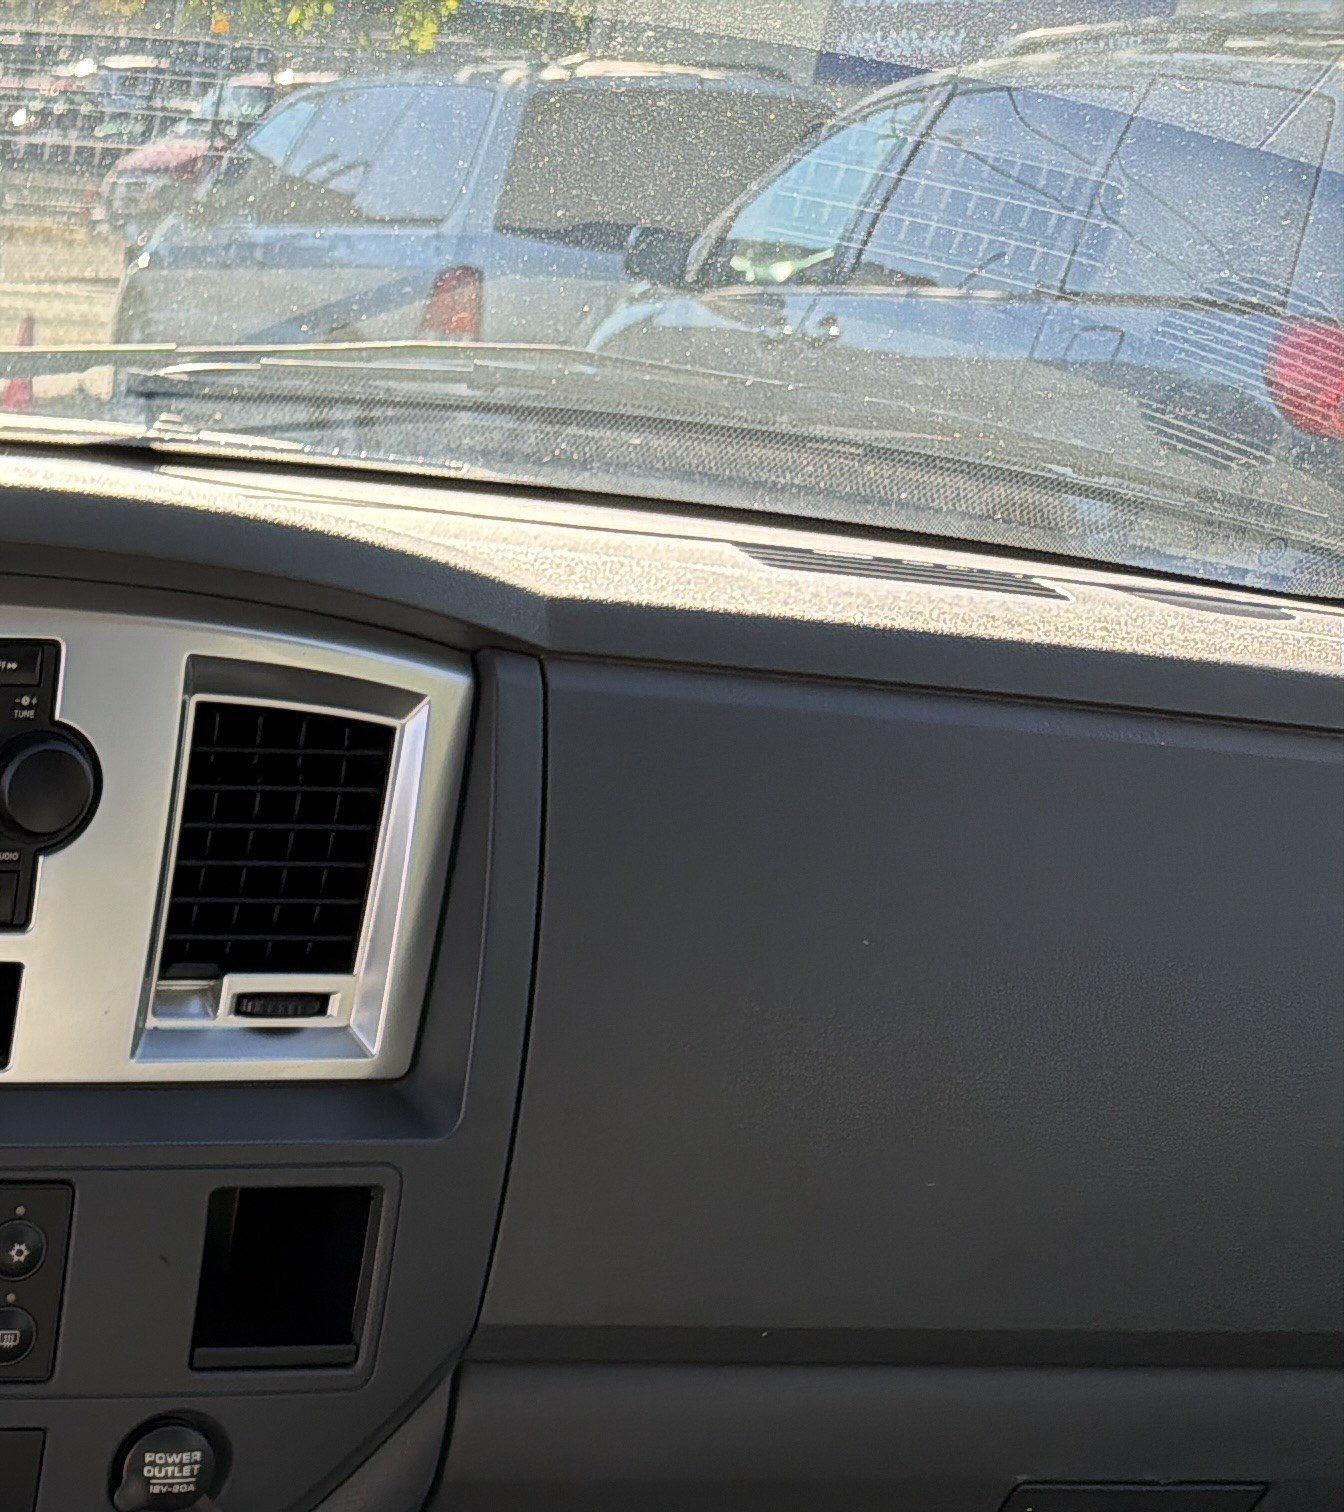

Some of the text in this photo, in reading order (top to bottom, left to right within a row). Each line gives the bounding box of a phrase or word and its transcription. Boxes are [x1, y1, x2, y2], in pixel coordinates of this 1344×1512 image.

[14, 709, 35, 719] TUNE
[144, 1451, 202, 1464] POWER
[143, 1464, 200, 1477] OUTLET
